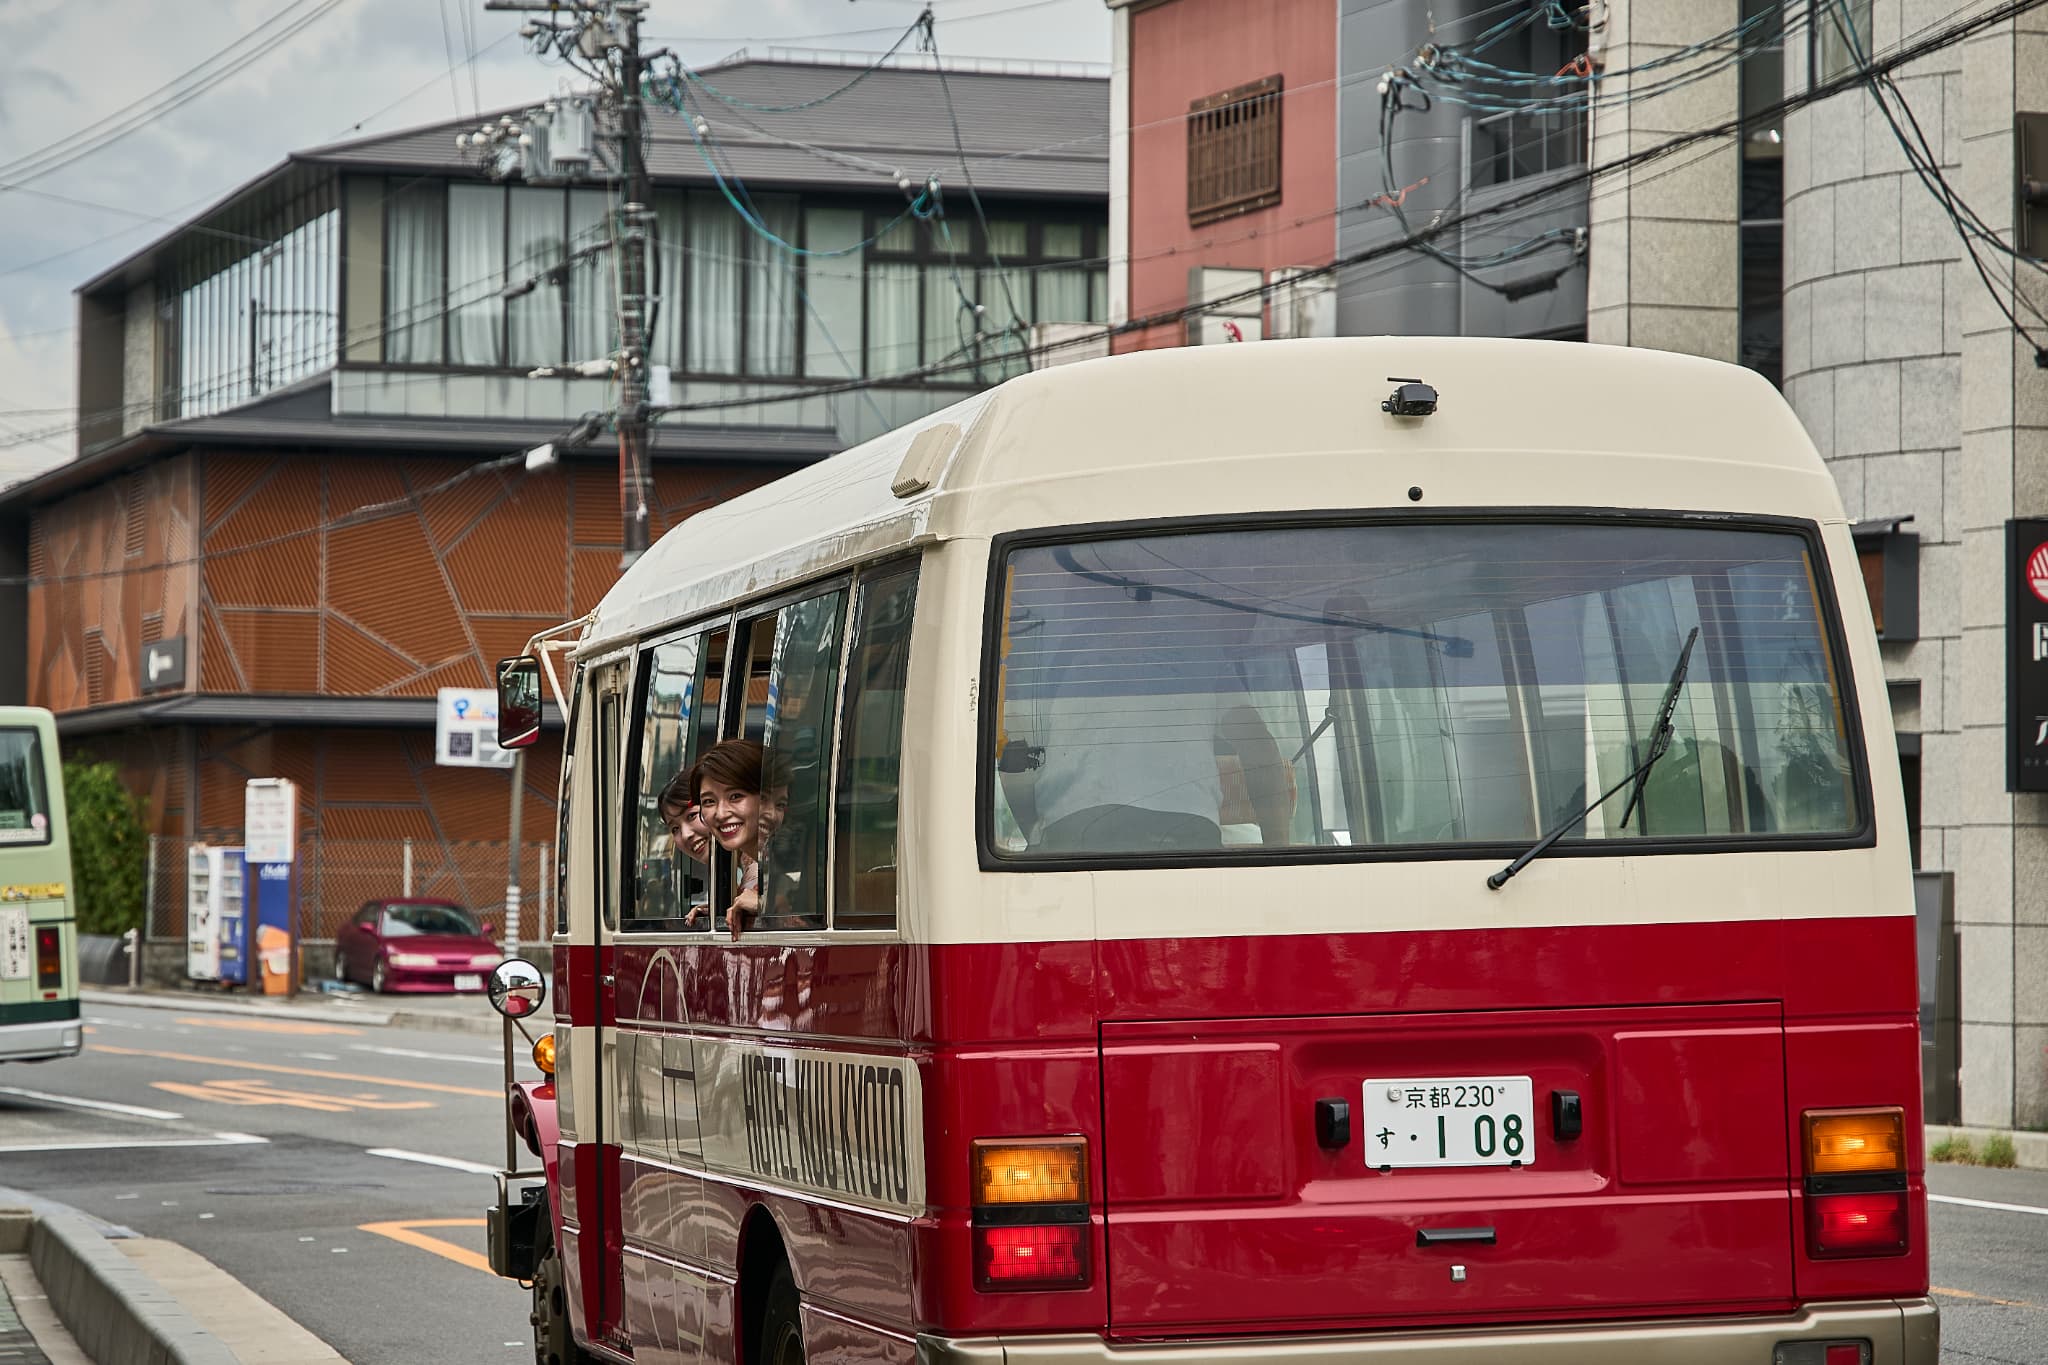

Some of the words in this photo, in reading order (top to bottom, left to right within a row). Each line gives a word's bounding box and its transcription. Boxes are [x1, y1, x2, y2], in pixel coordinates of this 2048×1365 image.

[742, 1053, 798, 1182] HOTEL
[794, 1058, 838, 1190] KUU
[838, 1062, 908, 1205] KYOTO
